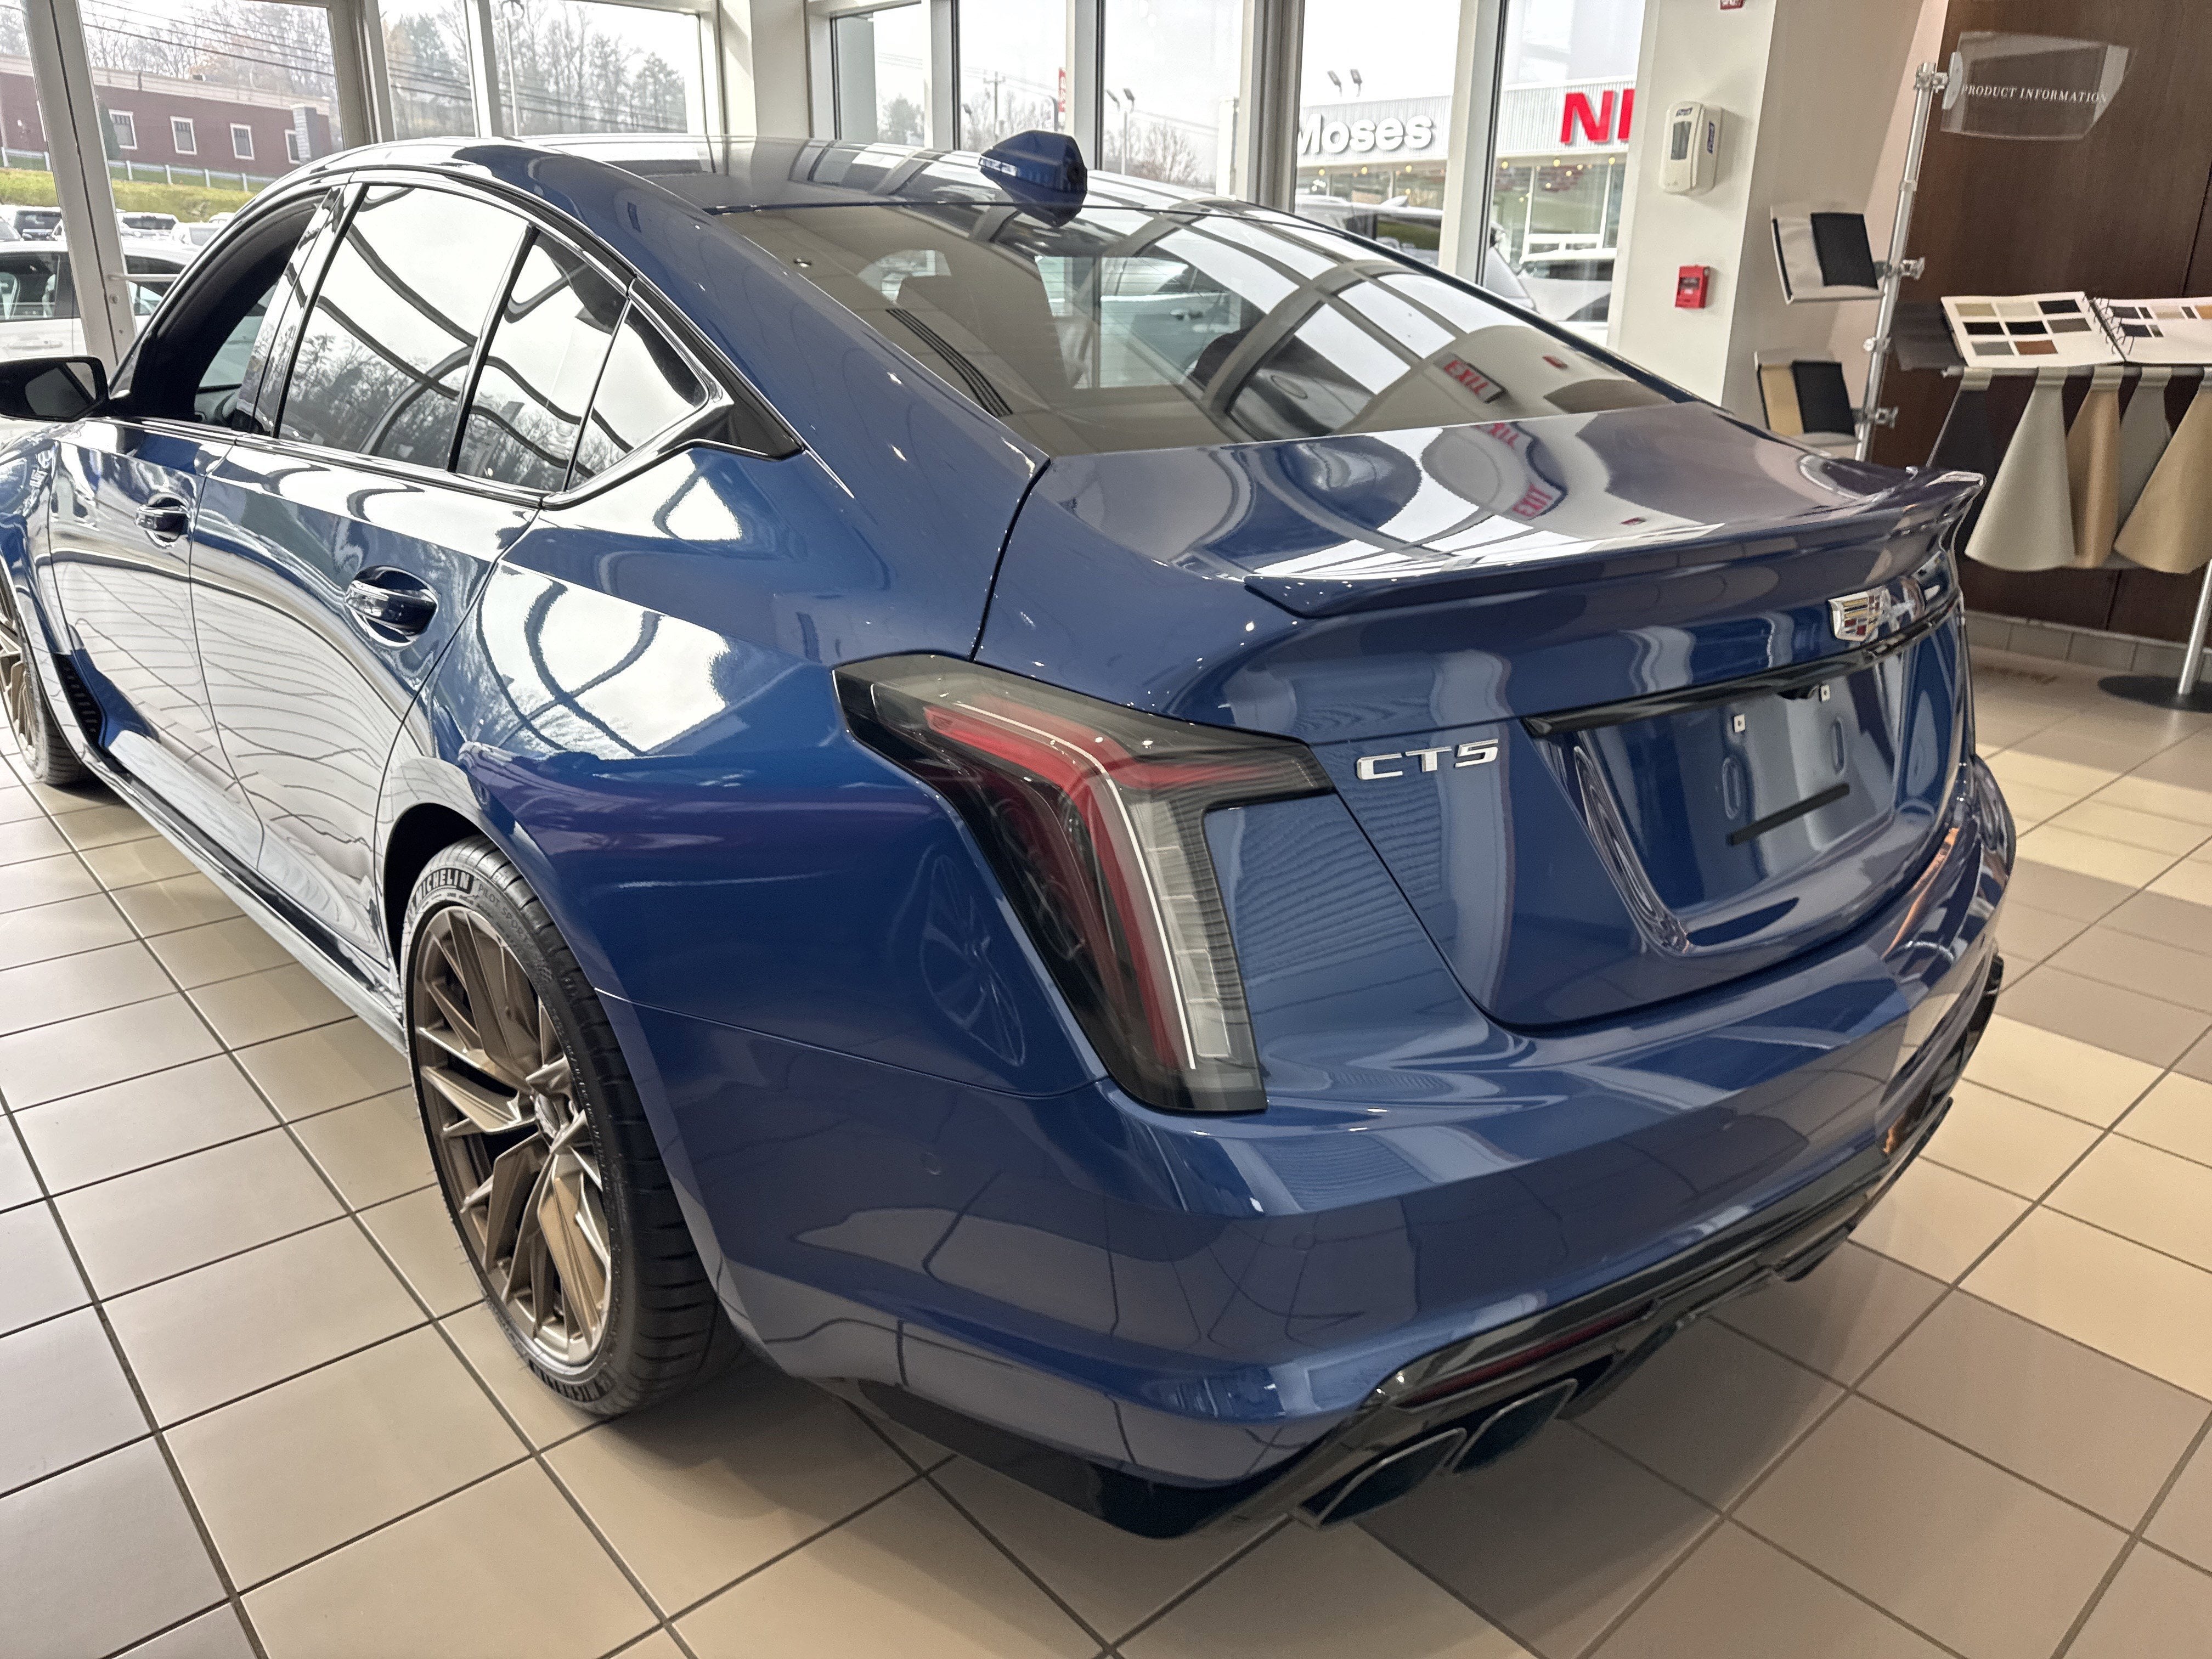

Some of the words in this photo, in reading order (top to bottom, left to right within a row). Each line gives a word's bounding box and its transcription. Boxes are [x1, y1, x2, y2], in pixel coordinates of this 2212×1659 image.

[1962, 84, 2017, 99] PRODUCT
[2019, 87, 2107, 104] INFORMATION
[1297, 112, 1432, 154] Moses
[1560, 88, 1635, 144] NI
[1356, 738, 1499, 780] CT5
[415, 868, 470, 906] MICHELIN
[478, 884, 500, 907] PILOT
